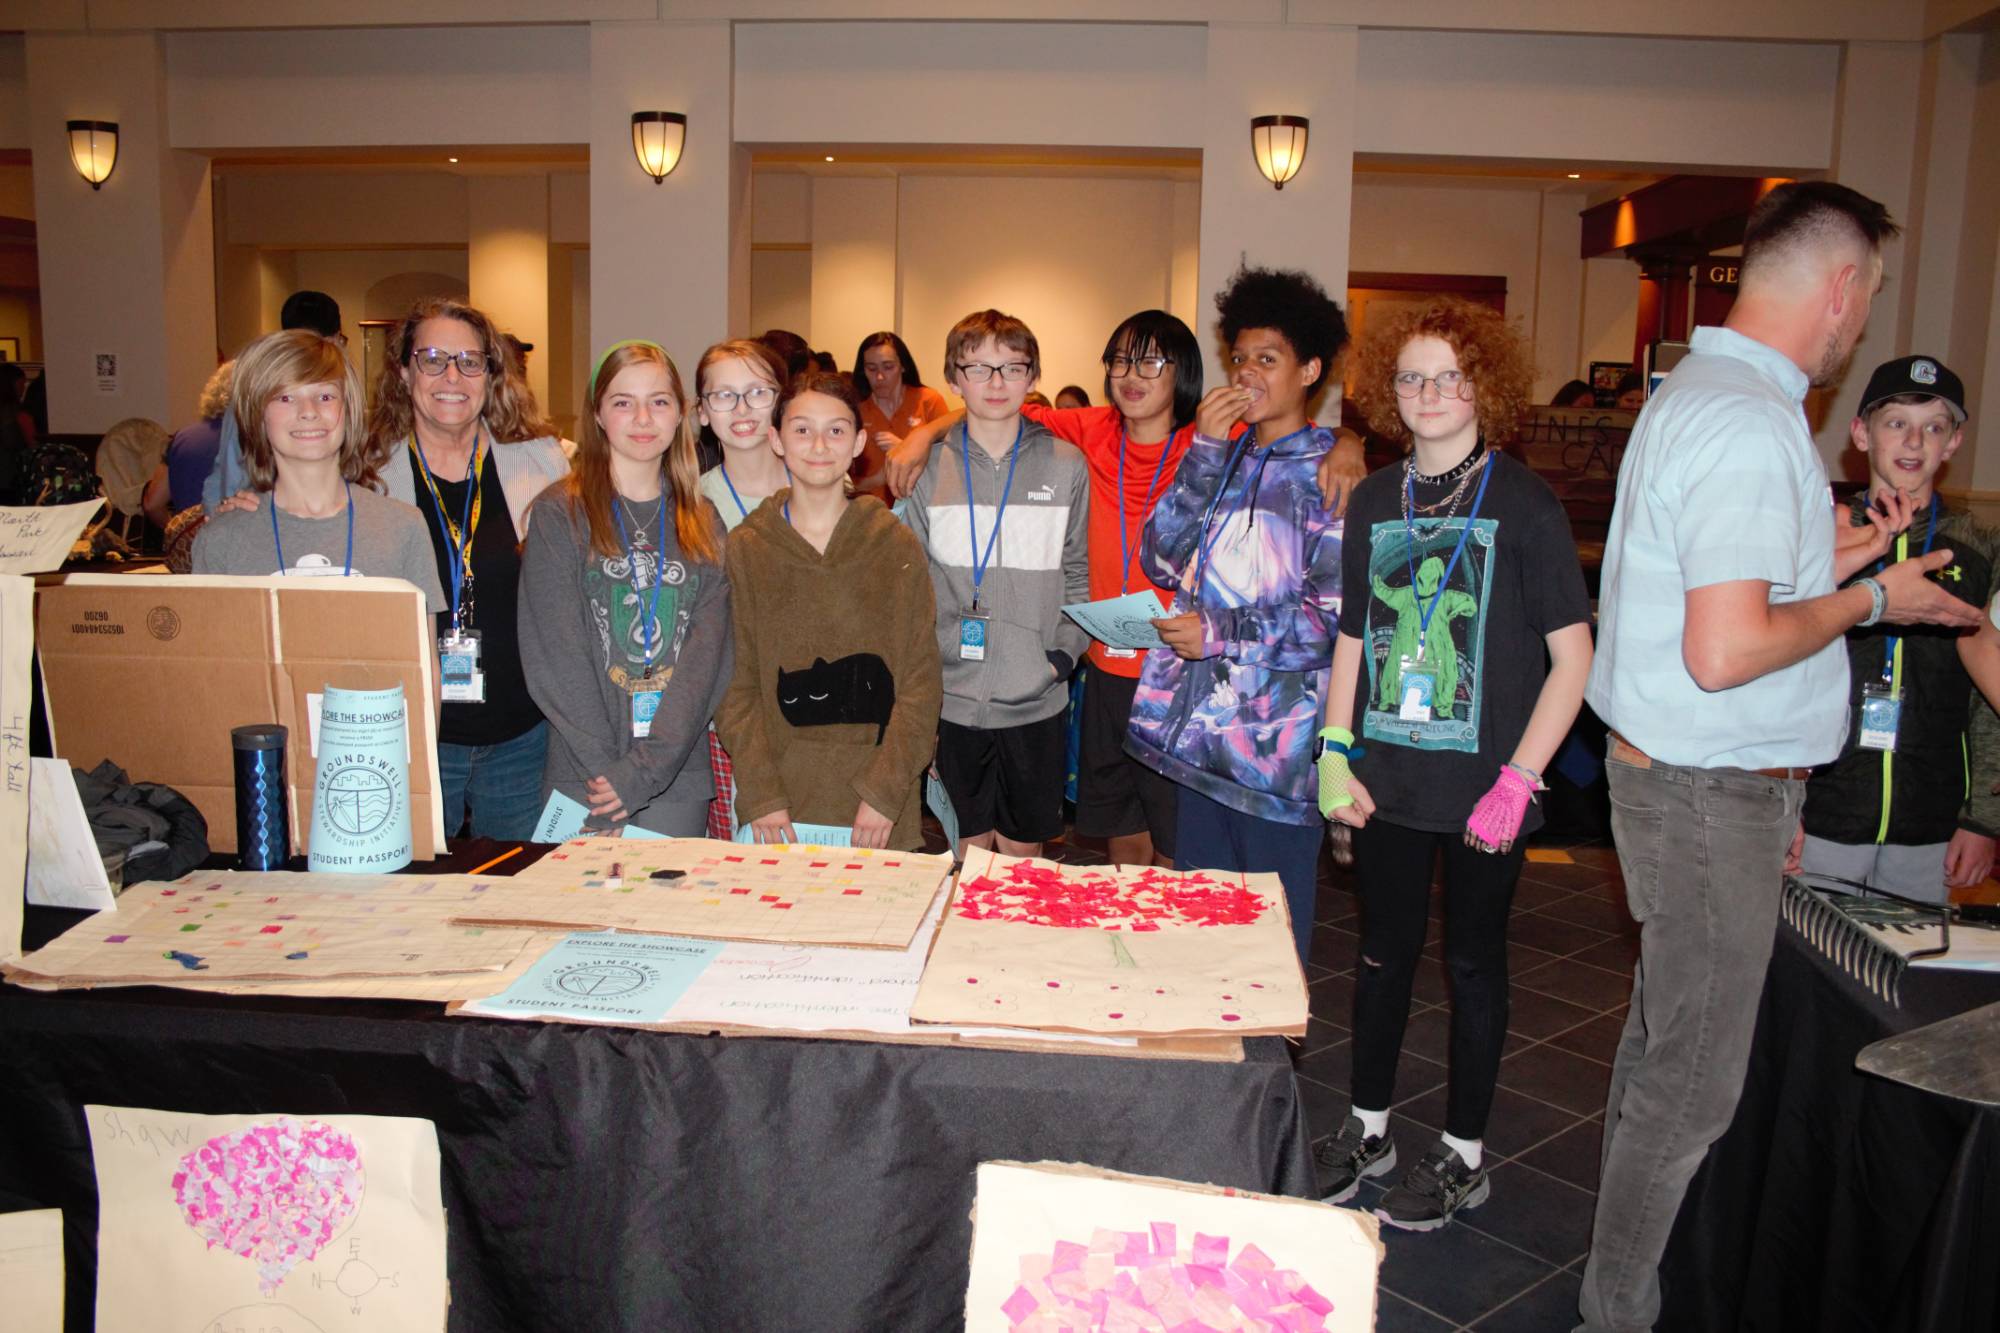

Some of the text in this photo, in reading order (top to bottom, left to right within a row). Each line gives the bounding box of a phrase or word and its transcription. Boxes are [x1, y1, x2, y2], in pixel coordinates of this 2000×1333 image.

[1027, 491, 1052, 501] PUMA
[340, 712, 357, 722] THE
[319, 754, 401, 790] GROUNDSWELL
[319, 804, 366, 847] STEWARDSHIP
[545, 806, 563, 838] STUDENT
[312, 845, 409, 865] STUDENT PASSPORT
[567, 939, 616, 947] EXPLORE
[641, 944, 707, 954] SHOWCASE
[506, 998, 644, 1015] STUDENT PASSPORT
[312, 1271, 322, 1289] N
[391, 1272, 400, 1288] S
